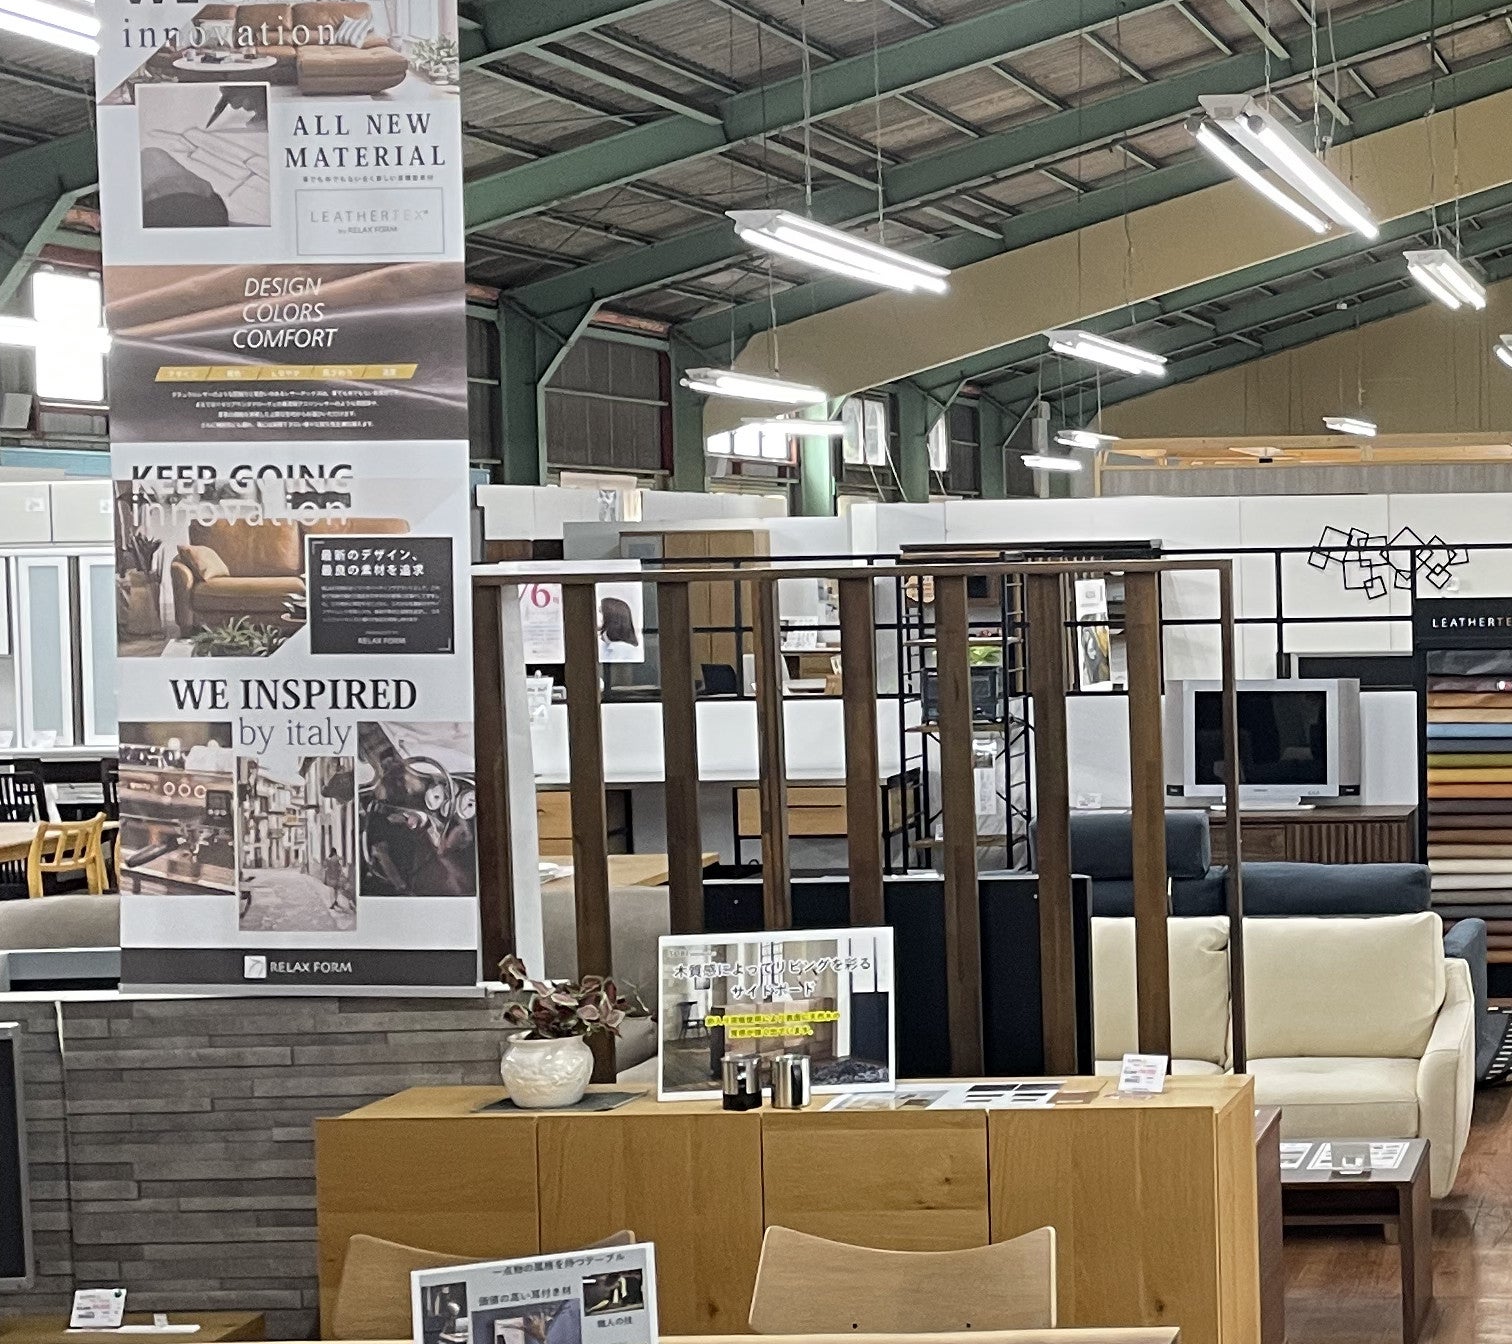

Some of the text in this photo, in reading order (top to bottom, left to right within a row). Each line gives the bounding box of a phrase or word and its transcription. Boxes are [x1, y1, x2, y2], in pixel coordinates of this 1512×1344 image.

[122, 17, 337, 50] innovation
[293, 112, 431, 136] ALL NEW
[284, 145, 446, 168] MATERIAL
[244, 277, 323, 297] DESIGN
[242, 302, 326, 323] COLORS
[232, 328, 339, 349] COMFORT
[132, 464, 354, 495] KEEP GOING
[169, 677, 417, 711] WE INSPIRED
[238, 716, 353, 755] by italy
[269, 959, 353, 975] RELAX FORM
[672, 956, 872, 979] 木質感によってリビングを彩る
[730, 981, 818, 1000] サイドボード
